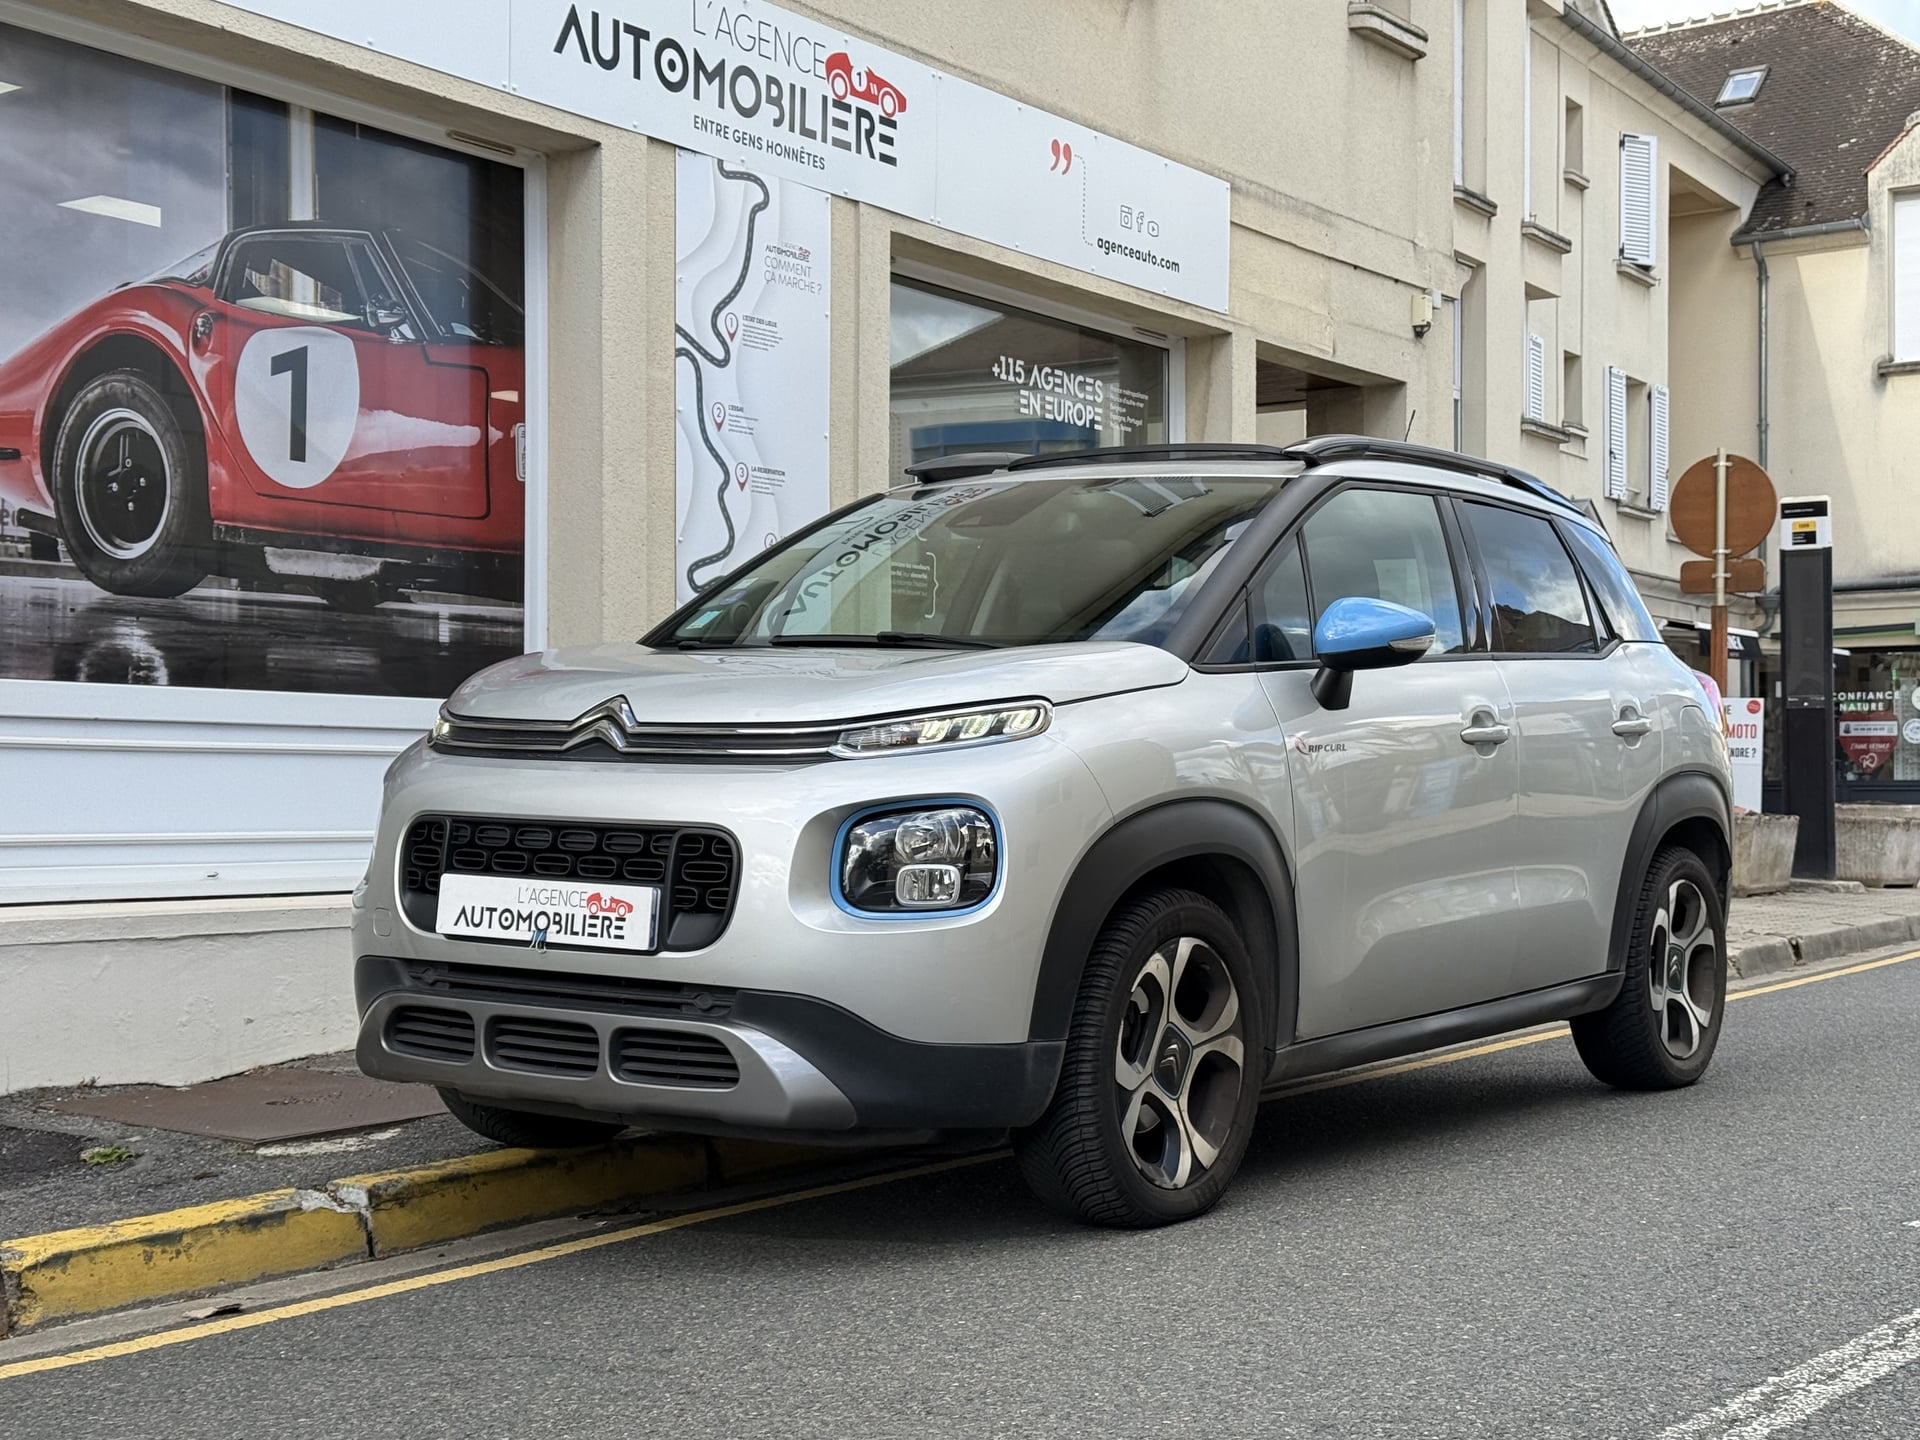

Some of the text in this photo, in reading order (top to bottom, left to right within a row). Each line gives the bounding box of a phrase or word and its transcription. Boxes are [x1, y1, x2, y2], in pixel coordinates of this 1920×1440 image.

[694, 0, 826, 80] L'AGENCE
[694, 115, 826, 170] ENTRE GENS HONNÊTES
[764, 255, 812, 278] COMMENT
[1097, 237, 1180, 273] agenceauto.com
[764, 270, 777, 285] ÇA
[778, 273, 816, 294] MARCHE
[992, 355, 1103, 403] +115 AGENCES
[271, 345, 309, 463] 1
[716, 407, 722, 418] 2
[1020, 389, 1103, 431] EN EUROPE
[739, 467, 745, 478] 3
[1839, 702, 1884, 712] NATURE
[1726, 723, 1757, 739] MOTO
[1308, 743, 1347, 753] RIP CURL
[1728, 747, 1750, 758] NDRE
[517, 887, 587, 909] L'AGENCE
